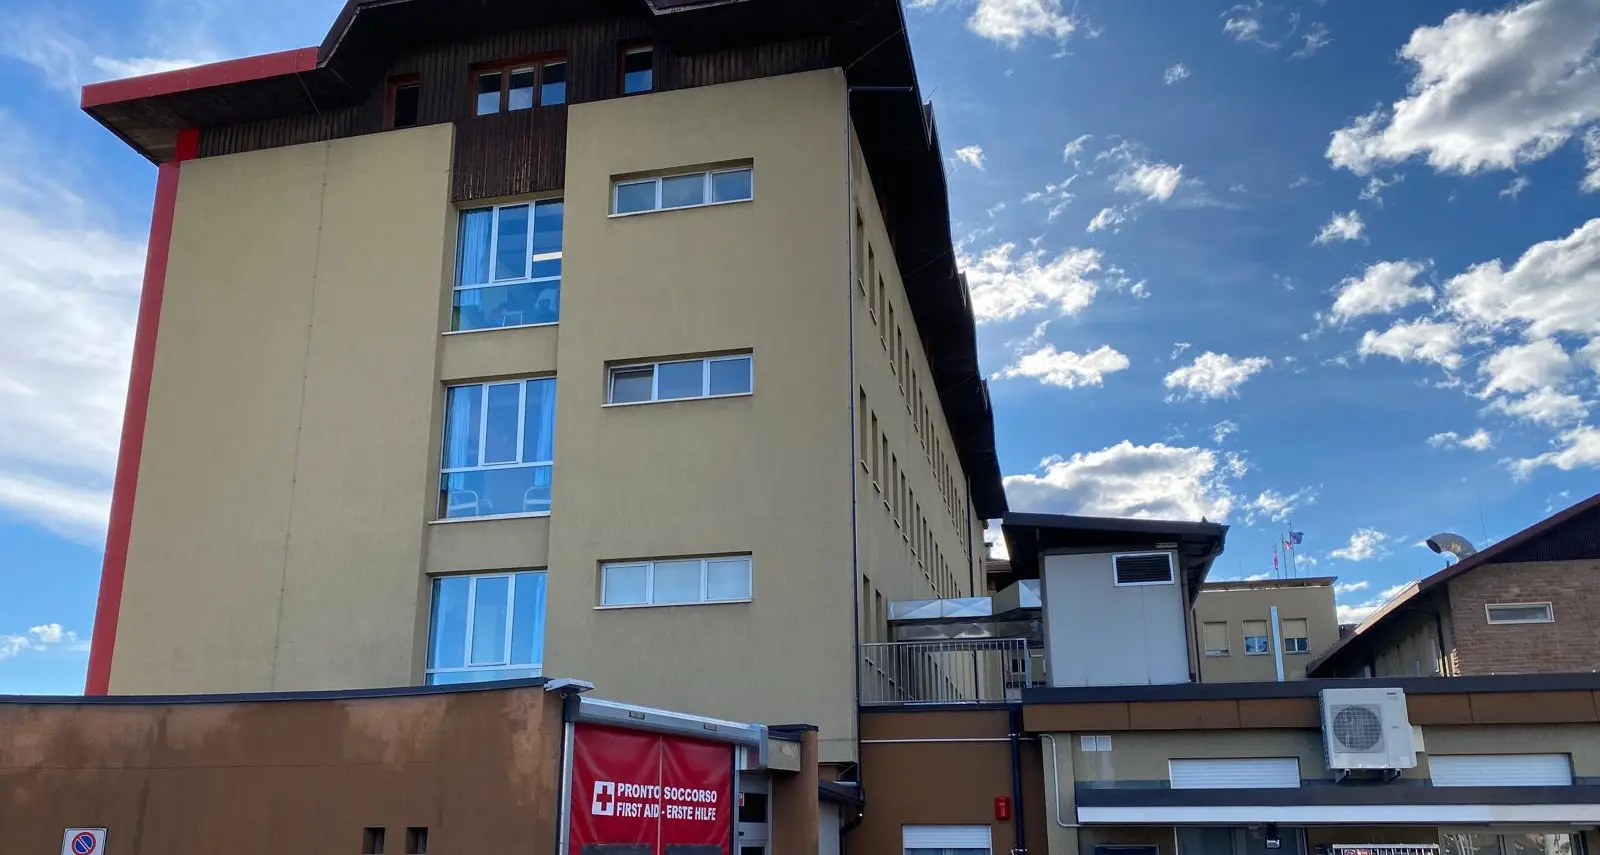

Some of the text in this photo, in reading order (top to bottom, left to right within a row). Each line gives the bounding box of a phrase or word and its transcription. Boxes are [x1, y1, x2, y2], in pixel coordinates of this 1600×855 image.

[617, 783, 717, 803] PRONTO SOCCORSO
[616, 802, 642, 817] FIRST
[644, 803, 659, 818] AID
[666, 804, 693, 820] ERSTE
[695, 807, 716, 821] HILFE
